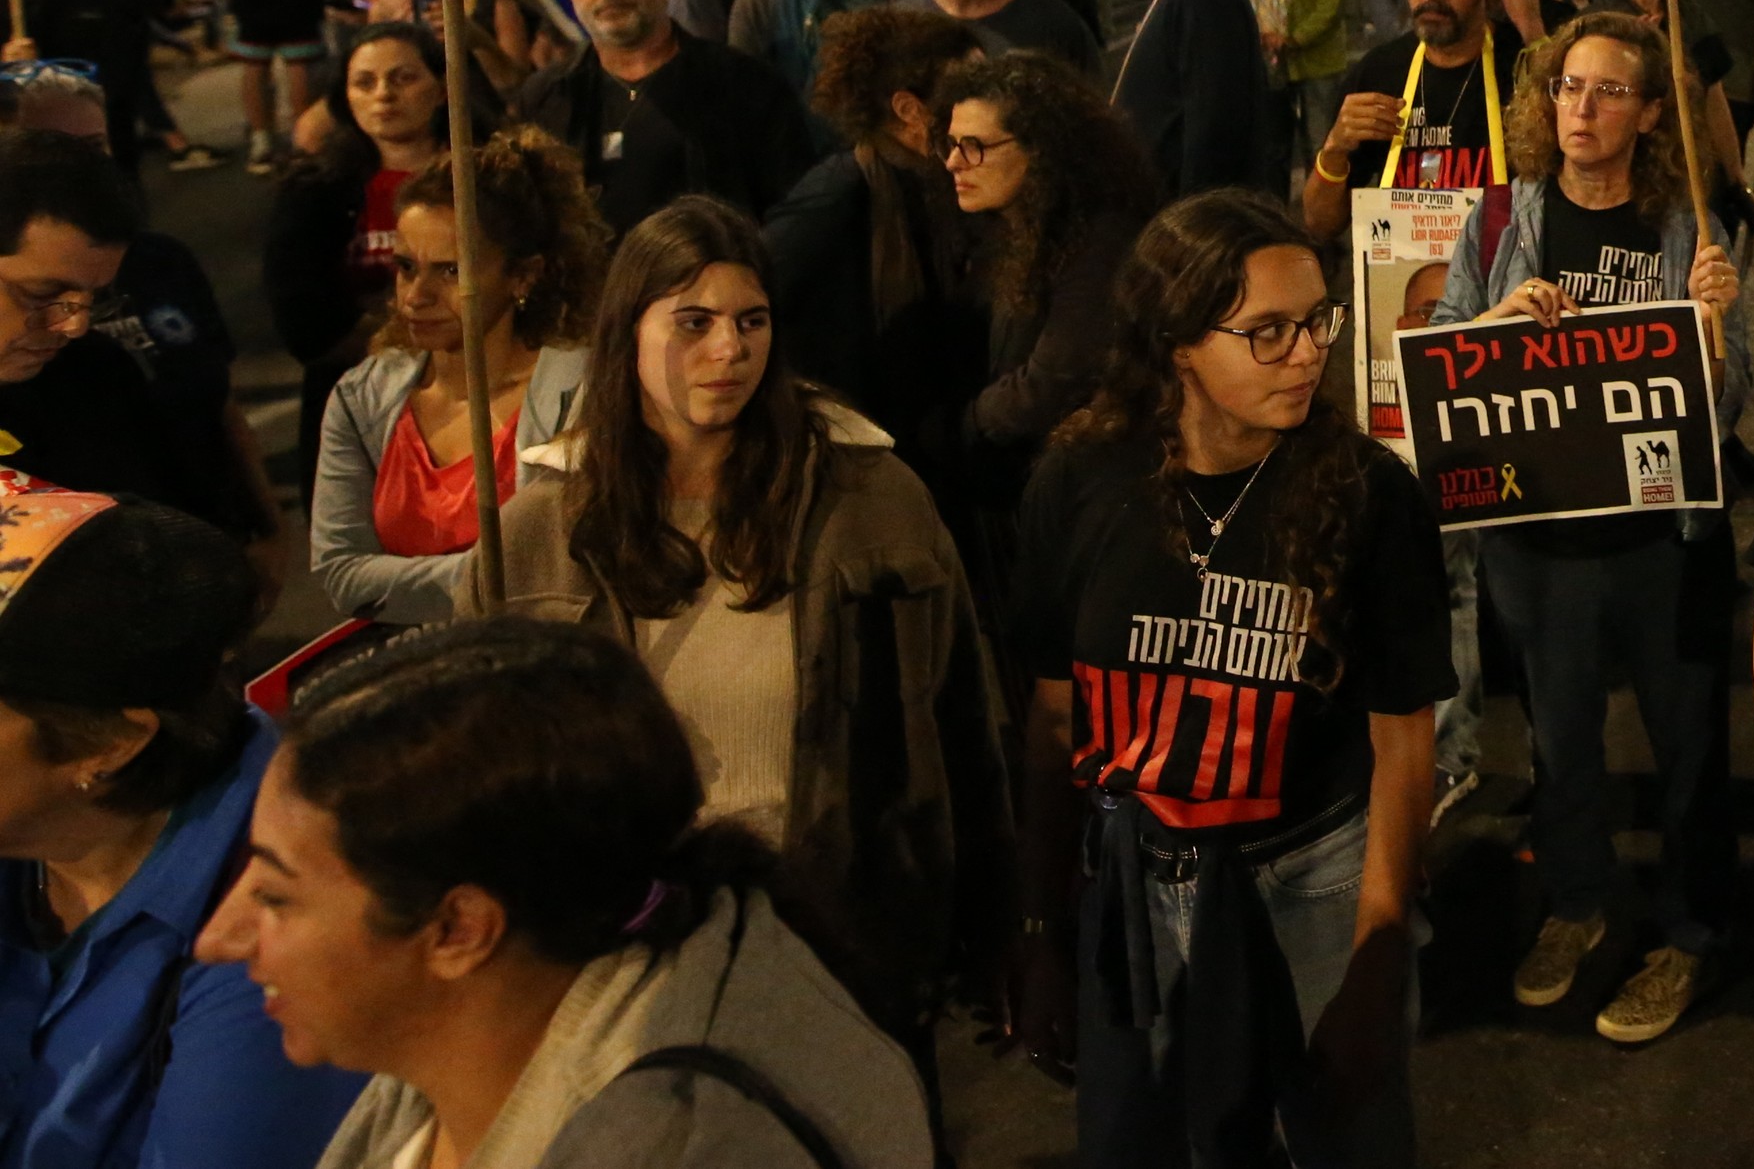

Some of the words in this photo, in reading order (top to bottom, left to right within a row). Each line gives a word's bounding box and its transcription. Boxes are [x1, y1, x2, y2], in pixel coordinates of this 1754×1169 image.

[1425, 333, 1501, 390] ילך
[1520, 322, 1678, 371] כשהוא
[1372, 381, 1396, 404] HIM
[1372, 406, 1404, 428] HOM
[1436, 385, 1577, 442] יחזרו
[1602, 376, 1687, 423] הם
[1438, 466, 1496, 495] כולנו
[1200, 572, 1314, 634] מחזירים
[1127, 614, 1224, 671] הביתה
[1225, 627, 1308, 683] אותם
